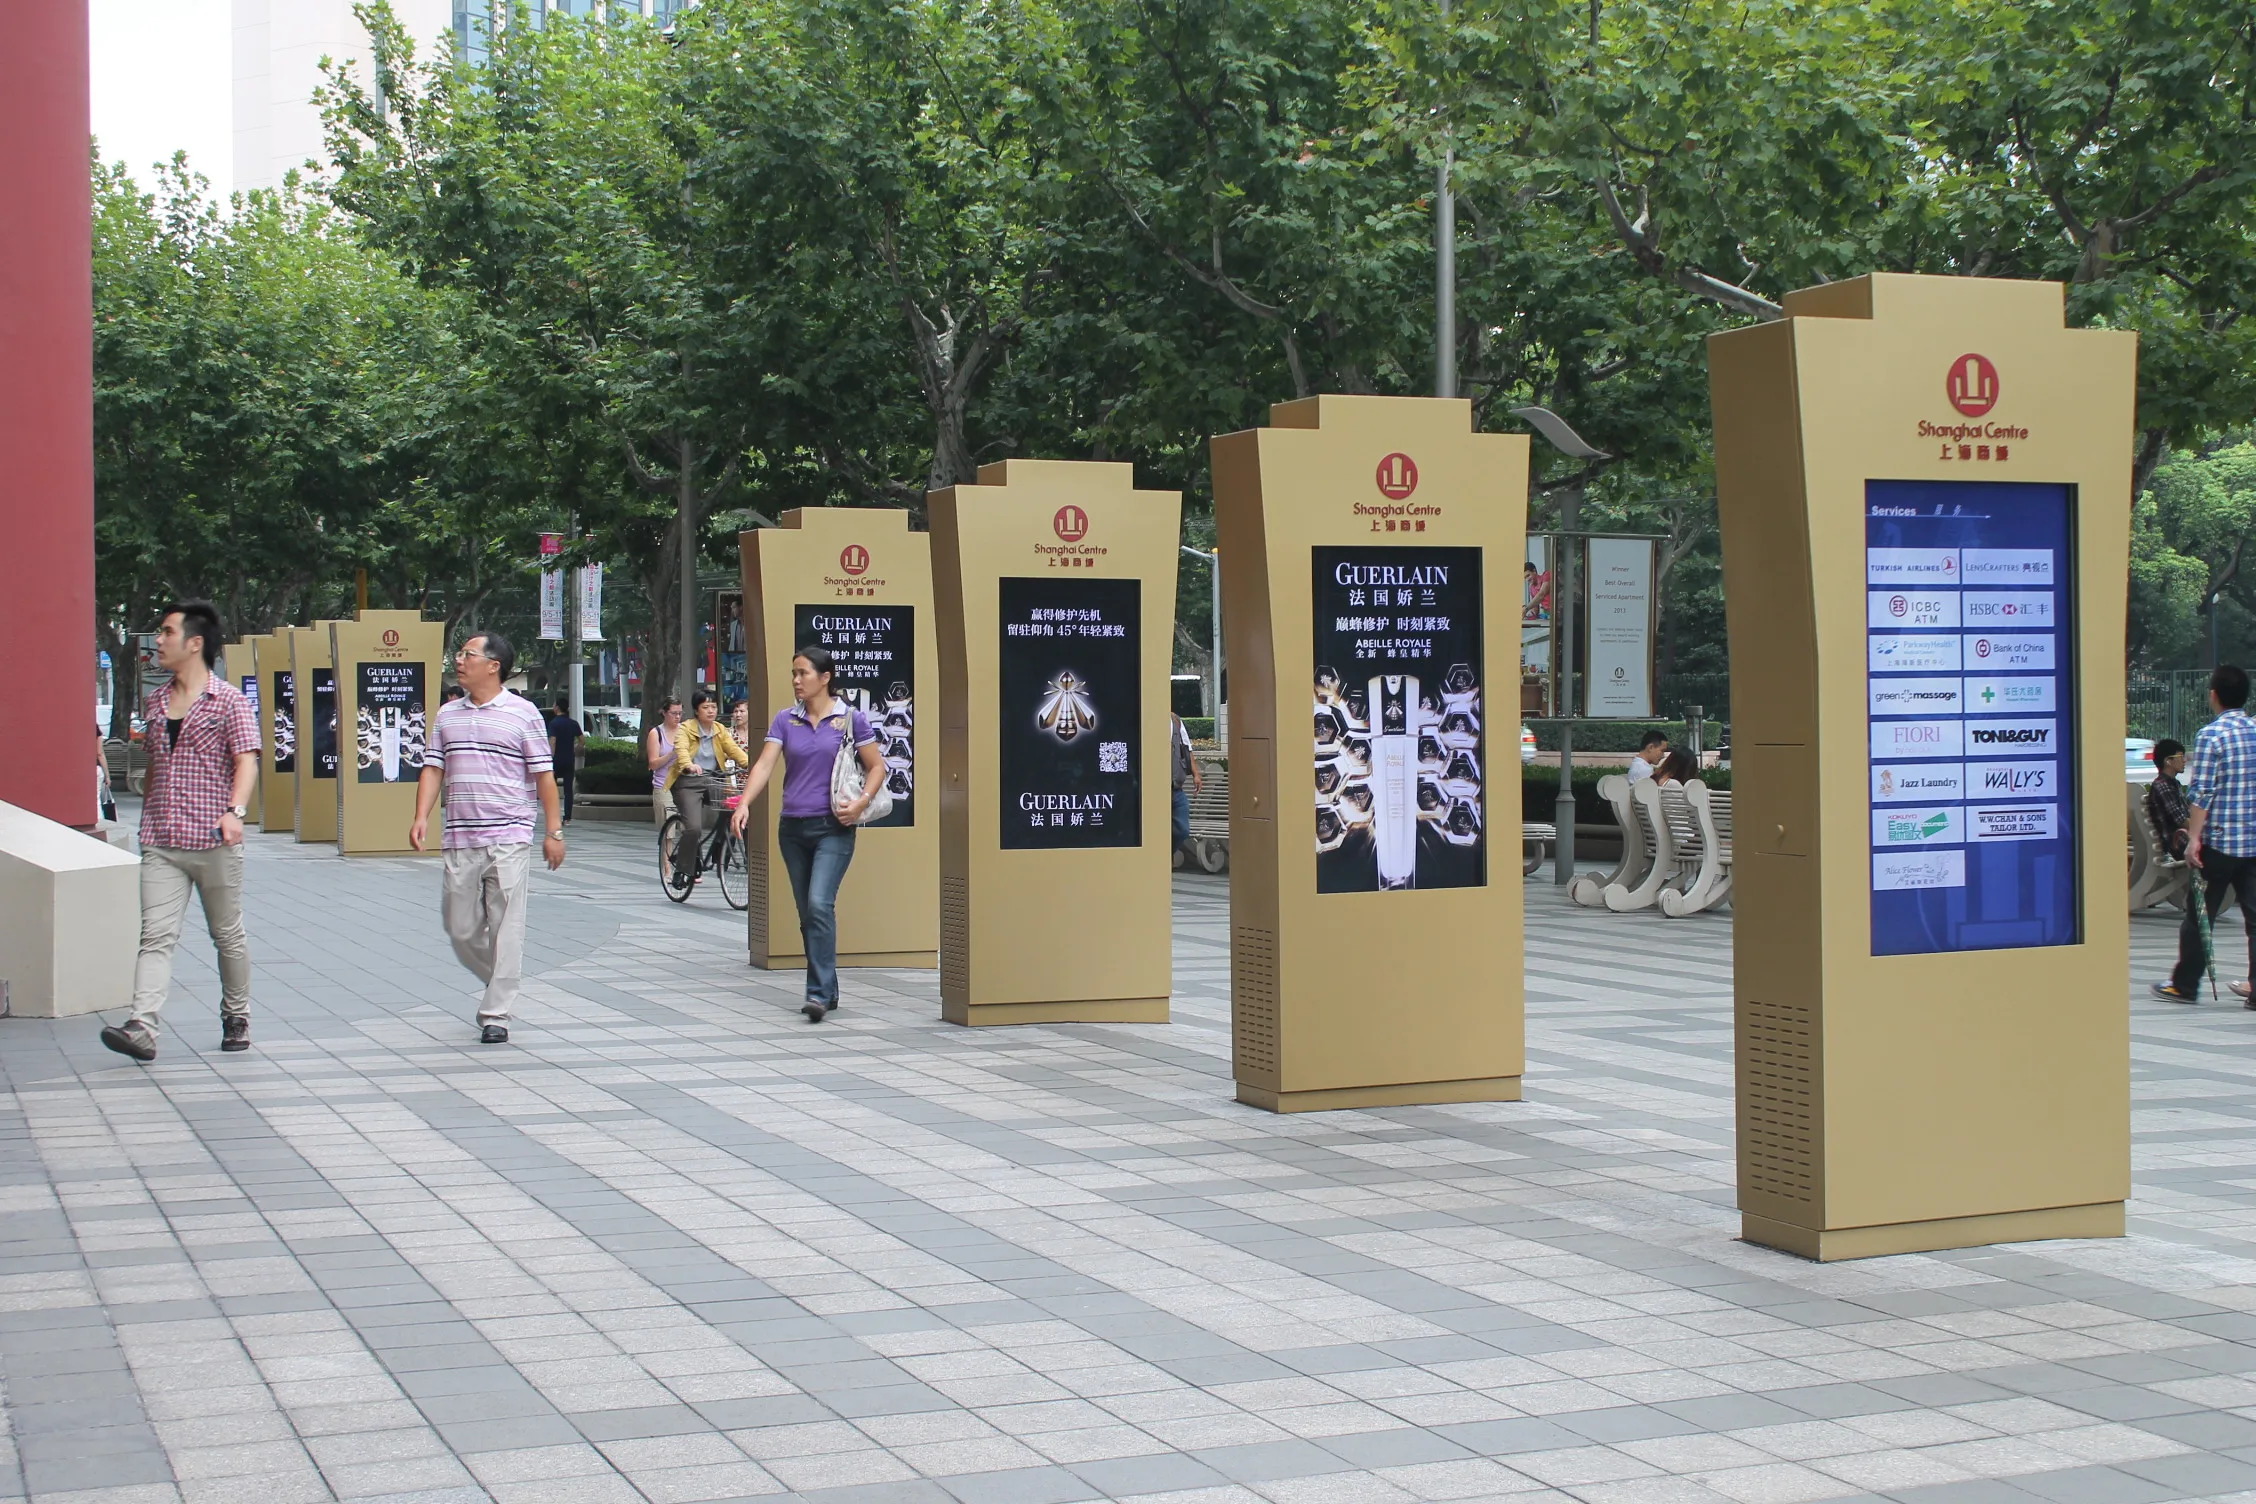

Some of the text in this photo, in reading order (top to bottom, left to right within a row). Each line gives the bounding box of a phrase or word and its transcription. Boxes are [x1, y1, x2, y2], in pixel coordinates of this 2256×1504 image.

[1918, 420, 2029, 442] Shanghai Centre
[1353, 502, 1442, 518] Shanghai Centre
[1871, 505, 1917, 516] Services
[1370, 519, 1426, 532] 上海商城
[1034, 543, 1108, 556] Shanghai Centre
[1335, 562, 1449, 585] GUERLAIN
[1871, 564, 1940, 572] TURKISH AIRLINES
[824, 576, 886, 587] Shanghai Centre
[1349, 588, 1436, 606] 法国娇兰
[1911, 601, 1941, 612] ICBC
[1969, 603, 2000, 615] HSBC
[1030, 608, 1101, 621] 赢得修护先机
[1914, 615, 1938, 624] ATM
[812, 614, 892, 631] GUERLAIN
[1396, 616, 1451, 632] 时刻紧致
[1007, 623, 1054, 636] 留驻仰角
[1078, 624, 1125, 637] 年轻紧致
[821, 632, 883, 644] 法国娇兰
[1355, 638, 1432, 648] ABEILLE ROYALE
[1355, 648, 1377, 659] 全新
[1993, 643, 2045, 652] Bank of China
[854, 650, 893, 661] 时刻紧致
[366, 667, 413, 676] GUERLAIN
[1875, 691, 1957, 702] green massage
[1894, 726, 1941, 743] FIORI
[1972, 729, 2050, 743] TONI&GUY
[1900, 777, 1957, 789] Jazz Laundry
[1985, 768, 2046, 792] WALLY'S
[1019, 792, 1114, 811] GUERLAIN
[1030, 812, 1104, 827] 法国娇兰
[2018, 814, 2025, 822] &
[2026, 813, 2047, 822] SONS
[1888, 820, 1917, 831] Easy
[1990, 823, 2036, 832] TAILOR LTD.
